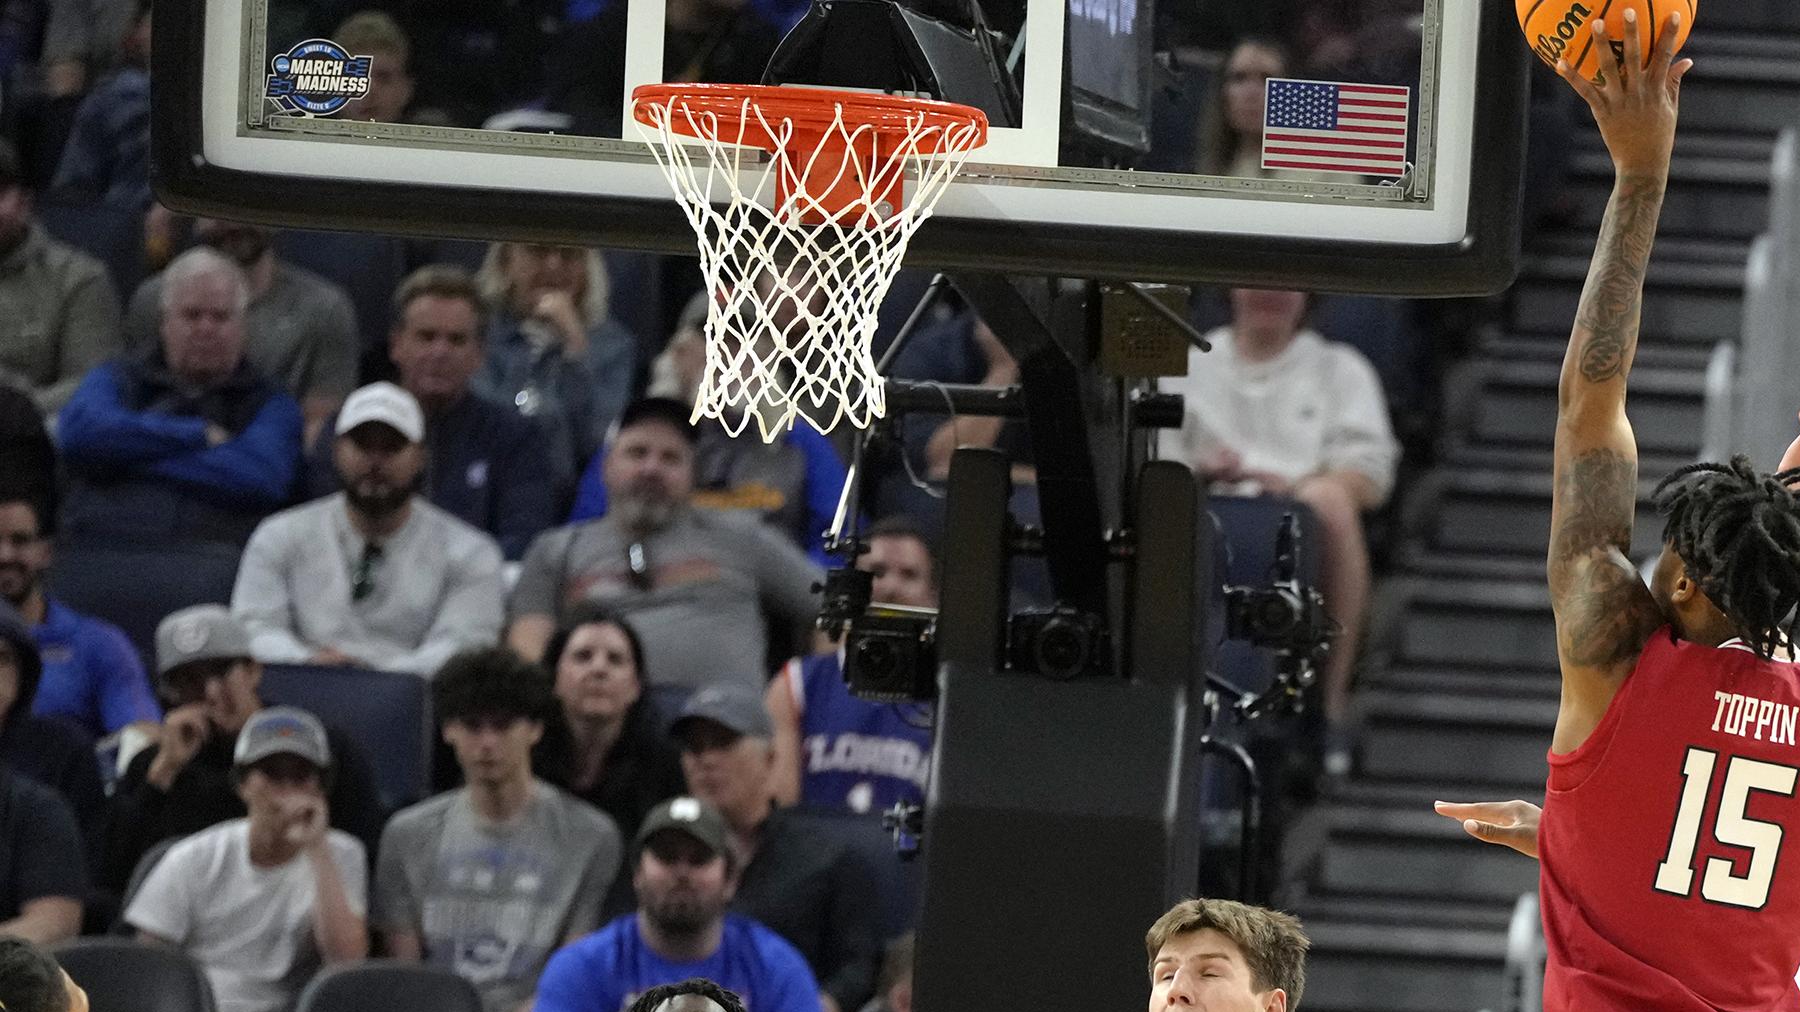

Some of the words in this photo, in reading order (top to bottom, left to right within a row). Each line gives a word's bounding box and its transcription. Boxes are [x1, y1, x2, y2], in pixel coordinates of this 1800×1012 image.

[290, 59, 344, 76] MARCH
[296, 75, 369, 93] MADNESS
[1711, 690, 1800, 746] TOPPIN
